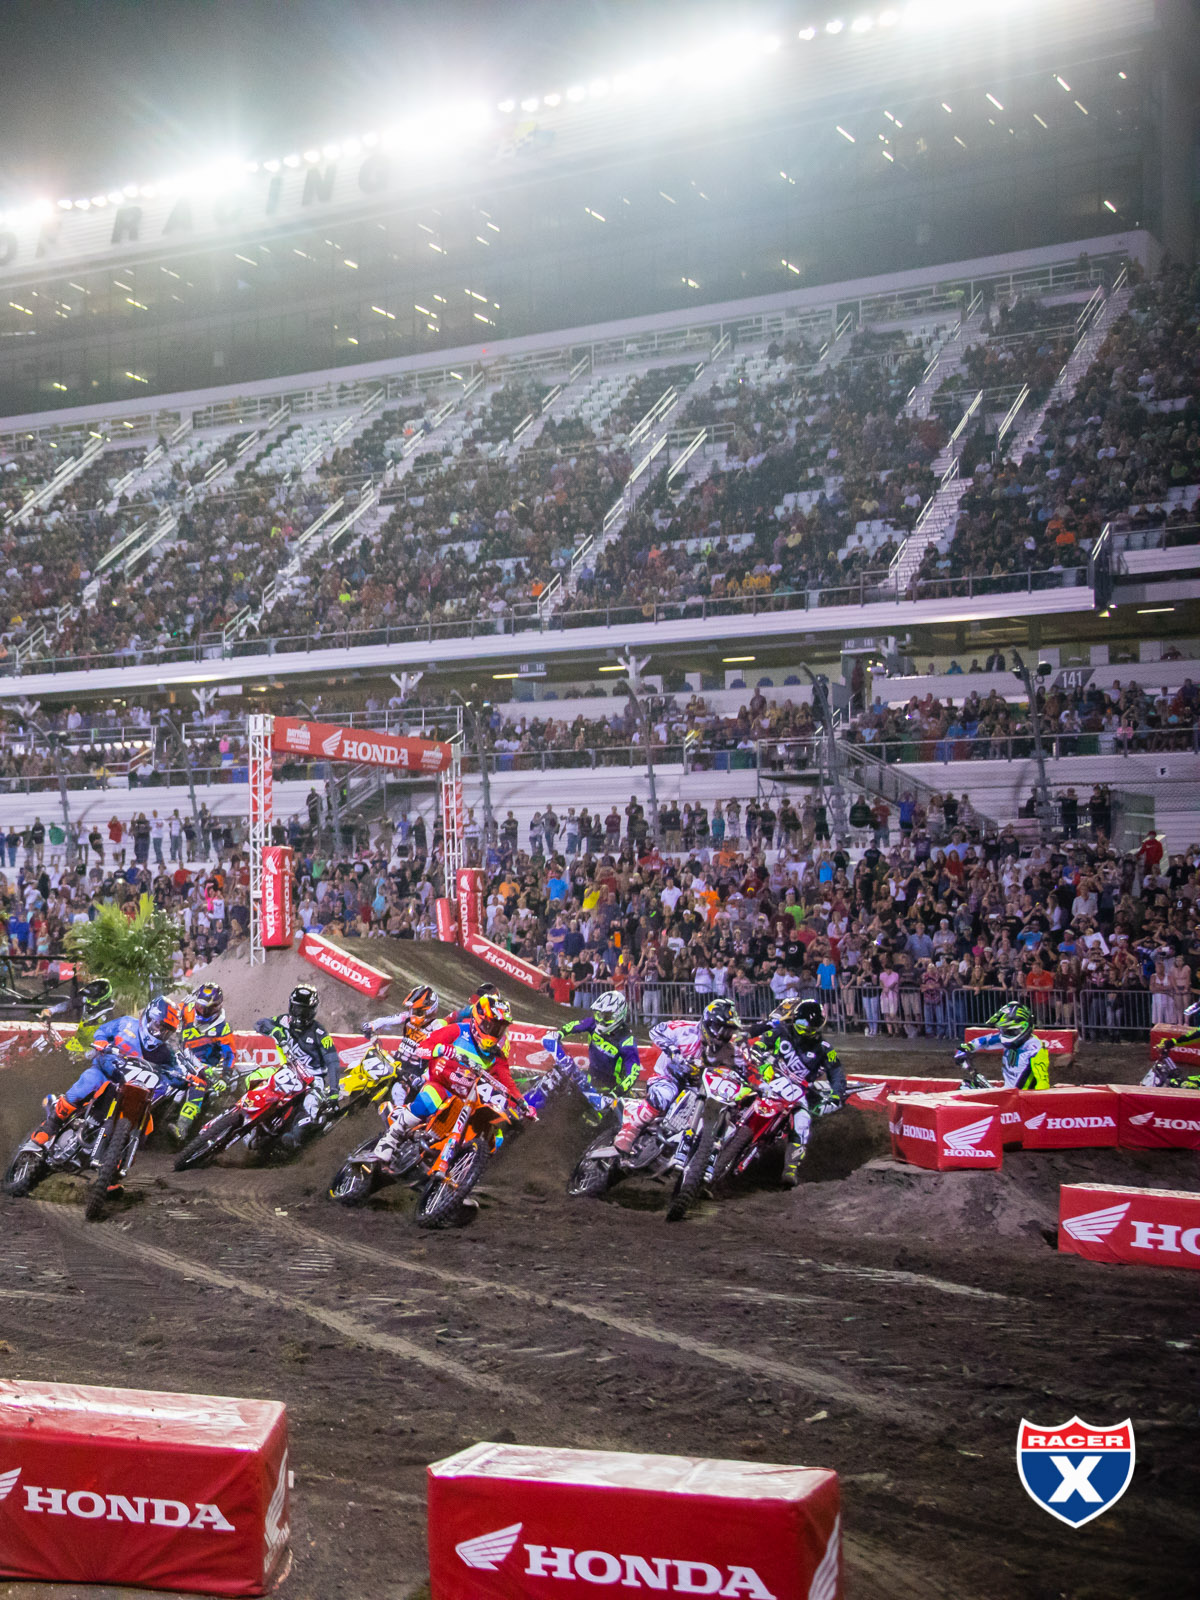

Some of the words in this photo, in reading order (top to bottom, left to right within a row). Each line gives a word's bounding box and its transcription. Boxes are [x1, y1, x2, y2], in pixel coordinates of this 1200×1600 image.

[1062, 671, 1082, 688] 141
[342, 739, 409, 766] HONDA
[265, 874, 276, 939] HONDA
[460, 891, 468, 946] HONDA
[318, 949, 373, 989] HONDA
[484, 949, 535, 985] HONDA
[123, 1064, 160, 1089] 70
[274, 1068, 303, 1095] 62
[709, 1074, 739, 1099] 16
[768, 1076, 803, 1102] 40
[477, 1083, 508, 1110] 44
[902, 1124, 937, 1142] HONDA
[1046, 1116, 1117, 1130] HONDA
[943, 1149, 996, 1158] HONDA
[23, 1485, 236, 1532] HONDA
[523, 1543, 777, 1600] HONDA
